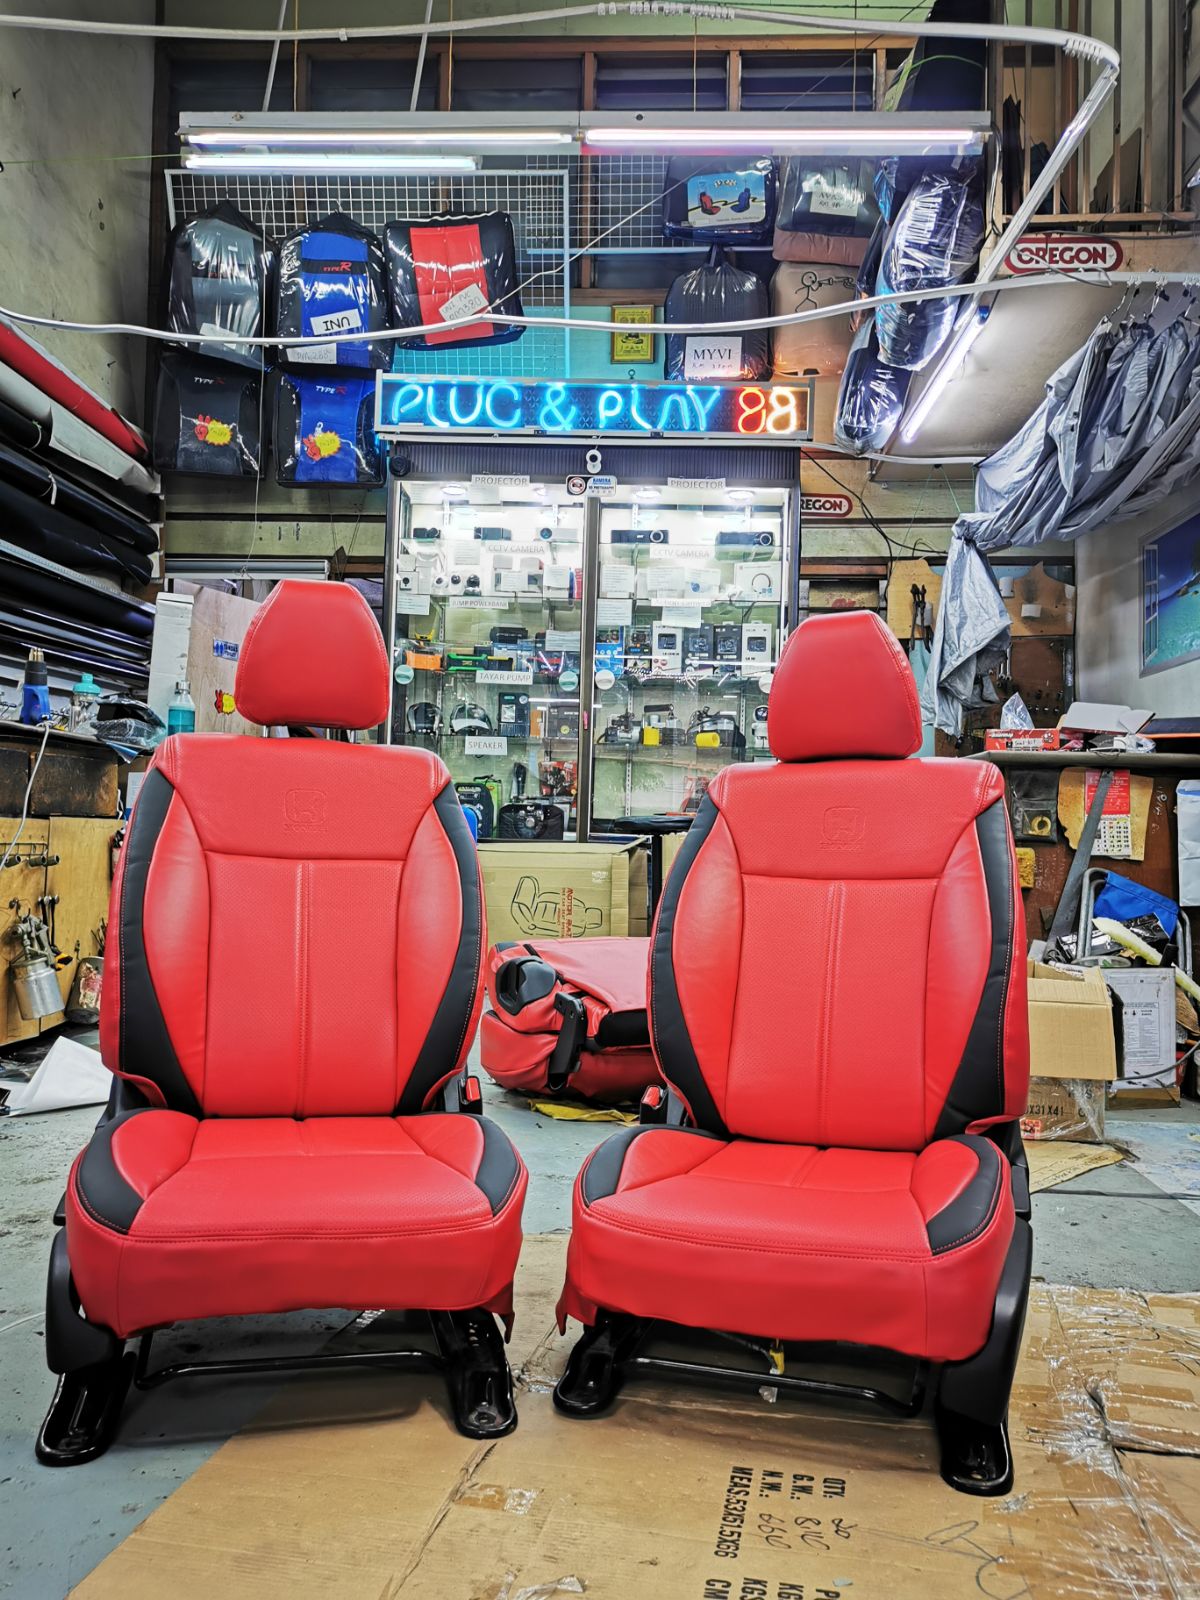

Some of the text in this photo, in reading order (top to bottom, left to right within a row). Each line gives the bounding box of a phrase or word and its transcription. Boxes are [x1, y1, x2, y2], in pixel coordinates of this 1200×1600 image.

[1016, 246, 1107, 265] OREGON
[693, 348, 731, 360] MYVI
[315, 385, 336, 394] TYPE
[539, 383, 576, 431] &
[598, 384, 720, 431] PLAY
[737, 386, 797, 434] 88
[474, 476, 528, 486] PROJECTOR
[670, 479, 724, 489] PROJECTOR
[800, 498, 843, 511] REGON
[487, 544, 545, 553] CCTV CAMERA
[653, 550, 710, 559] CCTV CAMERA
[479, 672, 531, 682] TAYAR PUMP
[467, 740, 503, 750] SPEAKER
[703, 1578, 732, 1600] CM
[776, 1582, 805, 1600] KG
